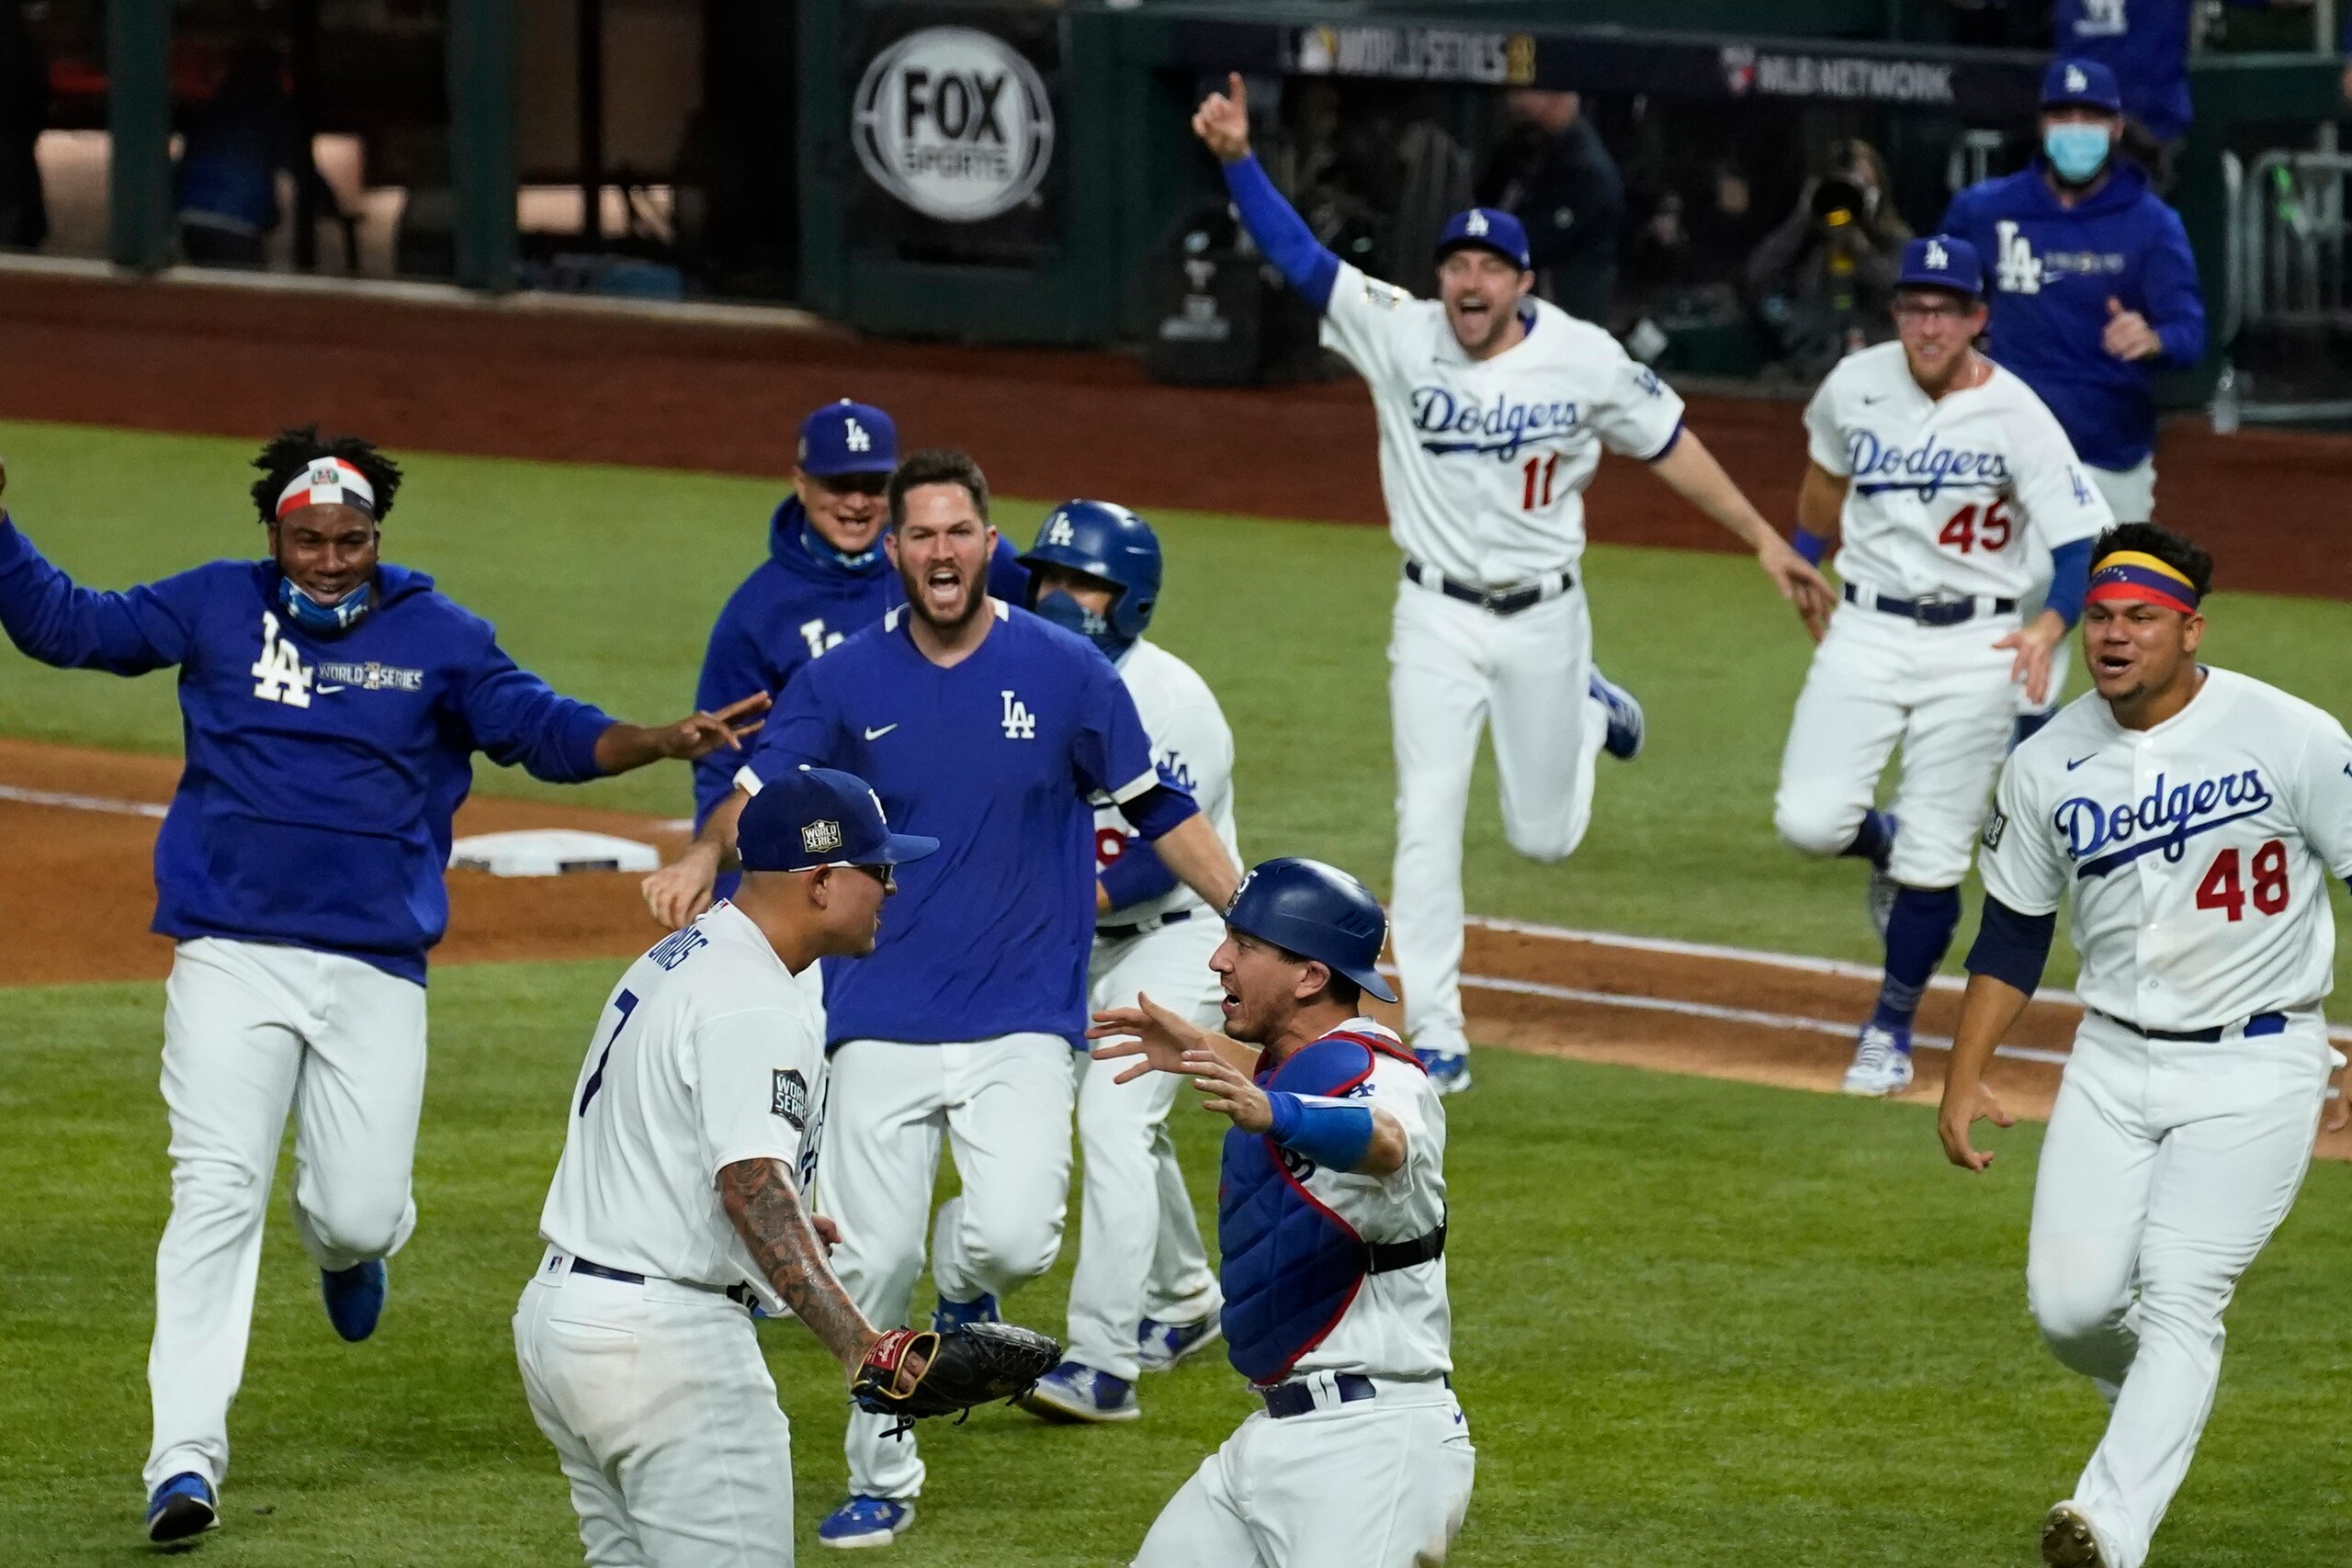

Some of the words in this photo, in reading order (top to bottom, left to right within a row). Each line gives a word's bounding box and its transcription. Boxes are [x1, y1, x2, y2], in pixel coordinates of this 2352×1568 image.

[904, 71, 1006, 143] FOX
[904, 143, 1009, 181] SPORTS
[1996, 220, 2042, 295] LA
[844, 418, 871, 452] LA
[1411, 386, 1586, 462] Dodgers
[1522, 450, 1559, 511] 11
[1849, 428, 2013, 502] Dodgers
[1048, 512, 1075, 547] LA
[1937, 499, 2011, 554] 45
[250, 610, 314, 709] LA
[318, 663, 363, 683] WORLD
[379, 668, 424, 691] SERIES
[1001, 690, 1035, 739] LA
[805, 825, 837, 840] WORLD
[807, 834, 839, 849] SERIES
[2054, 769, 2274, 878] Dodgers
[2197, 839, 2291, 922] 48
[579, 987, 639, 1118] 7
